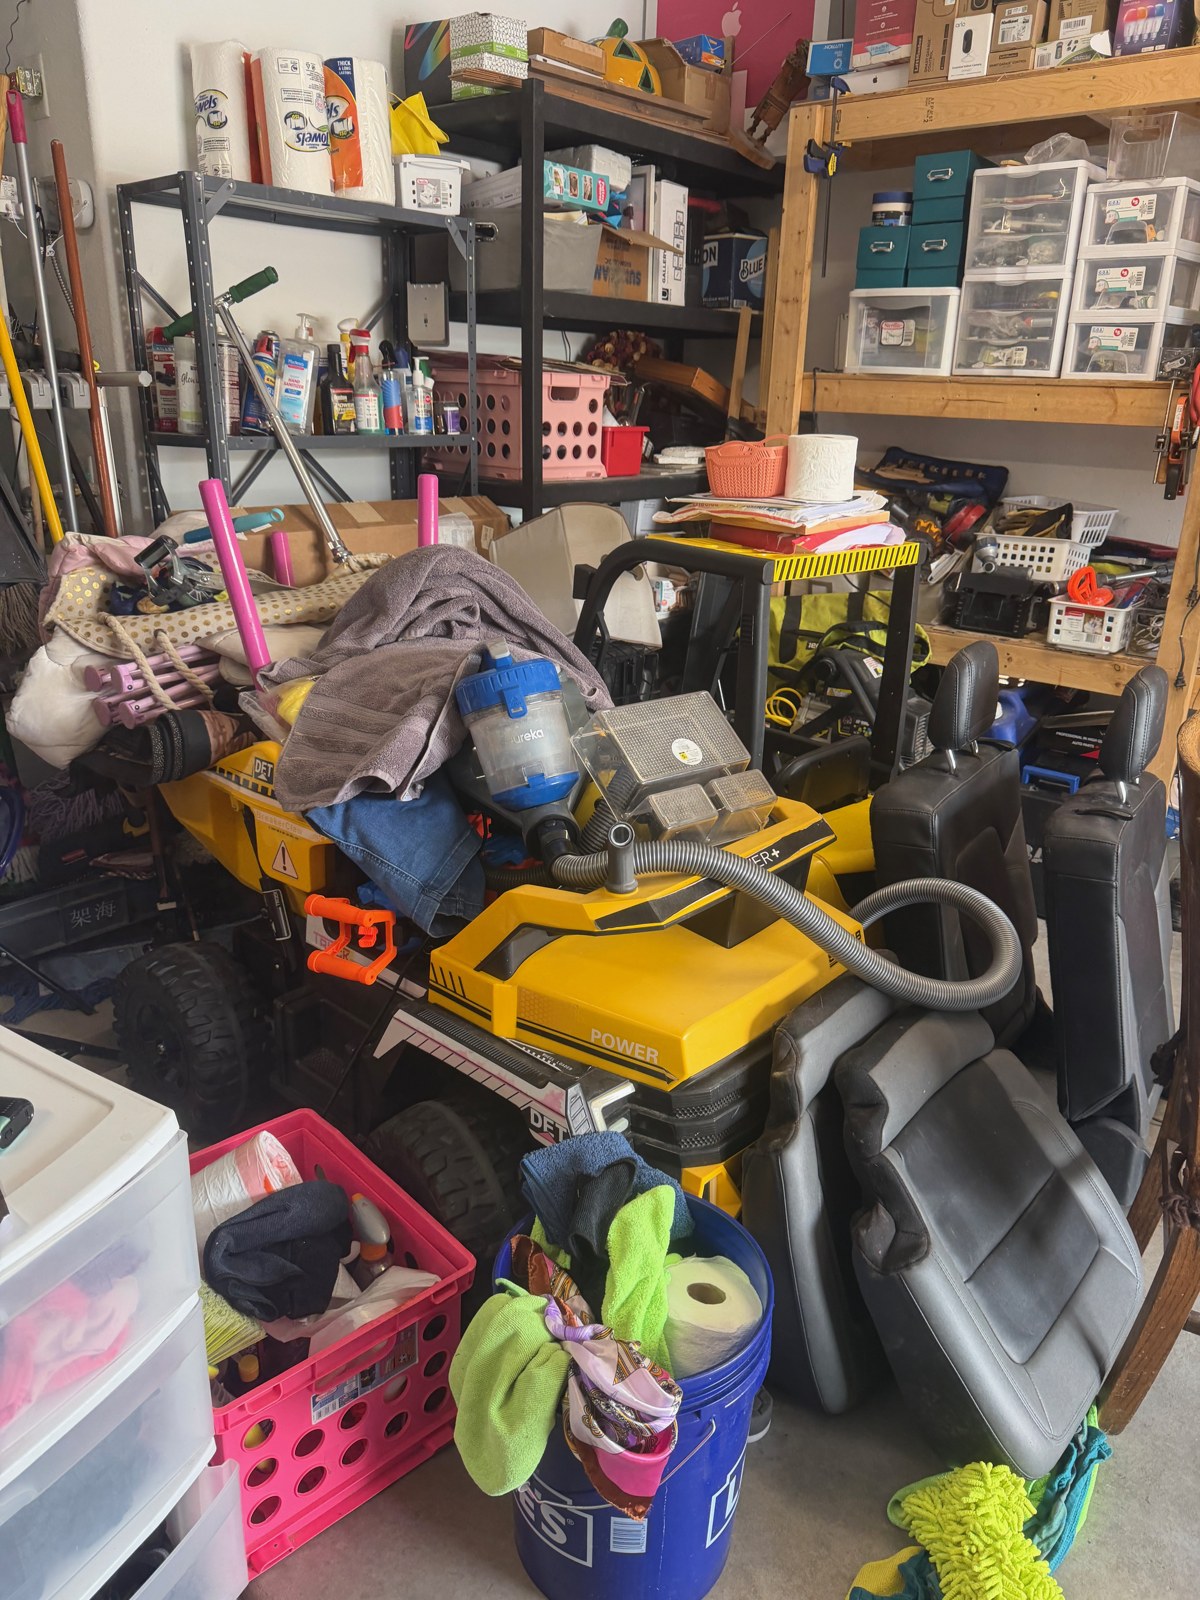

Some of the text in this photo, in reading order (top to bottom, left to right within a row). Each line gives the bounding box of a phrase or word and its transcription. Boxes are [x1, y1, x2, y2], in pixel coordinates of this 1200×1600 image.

[295, 132, 330, 147] Towels
[740, 257, 764, 280] BLUE
[283, 382, 305, 390] SANITIZER
[590, 1028, 659, 1066] POWER
